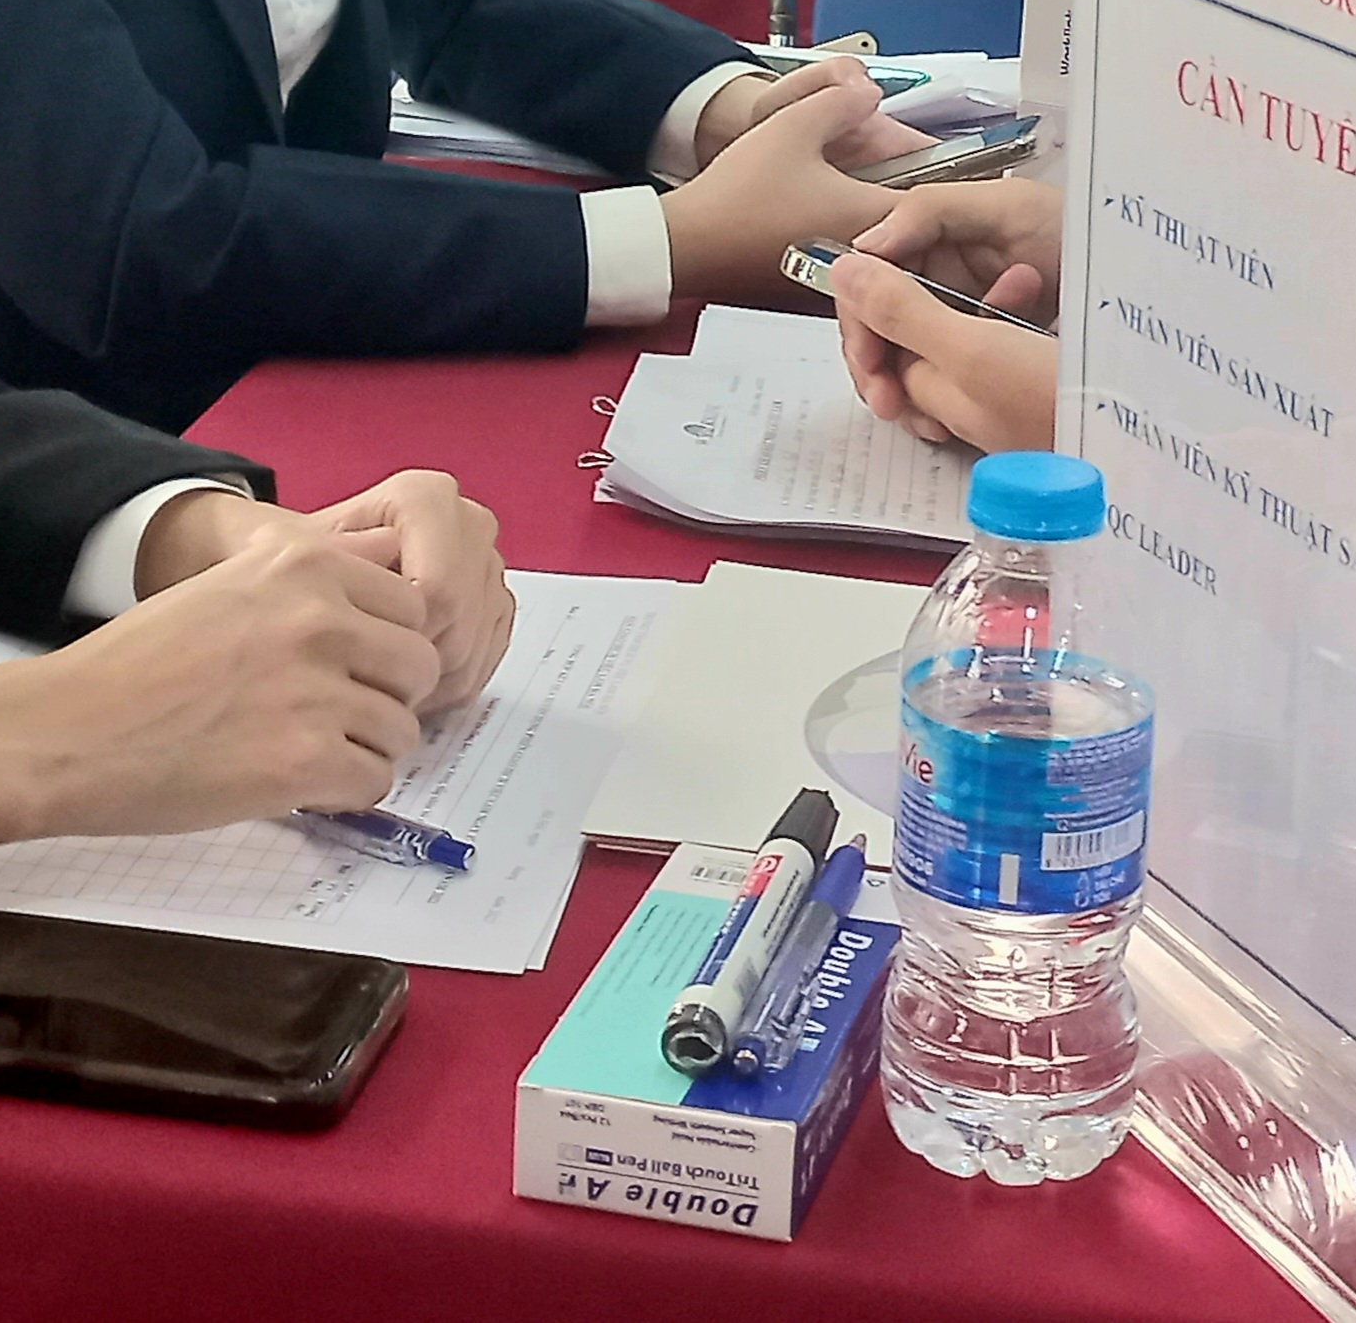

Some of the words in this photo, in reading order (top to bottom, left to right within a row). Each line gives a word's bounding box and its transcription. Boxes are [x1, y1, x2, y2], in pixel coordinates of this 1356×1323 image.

[1177, 55, 1248, 126] CẦN
[1120, 193, 1146, 228] KỸ
[1151, 208, 1221, 266] THUẬT
[1224, 246, 1277, 291] VIÊN
[1116, 296, 1170, 346] NHÂN
[1174, 328, 1222, 377] VIÊN
[1227, 357, 1268, 403] SẢN
[1273, 381, 1335, 439] XUẤT
[1111, 398, 1165, 453] NHÂN
[1168, 434, 1218, 483] VIÊN
[1222, 465, 1252, 506] KỸ
[1258, 486, 1334, 555] THUẬT
[1106, 503, 1135, 541] QC
[1138, 522, 1219, 596] LEADER
[616, 1153, 648, 1172] Pen
[651, 1158, 682, 1176] Ball
[686, 1164, 760, 1191] TriTouch
[624, 1183, 760, 1229] Double
